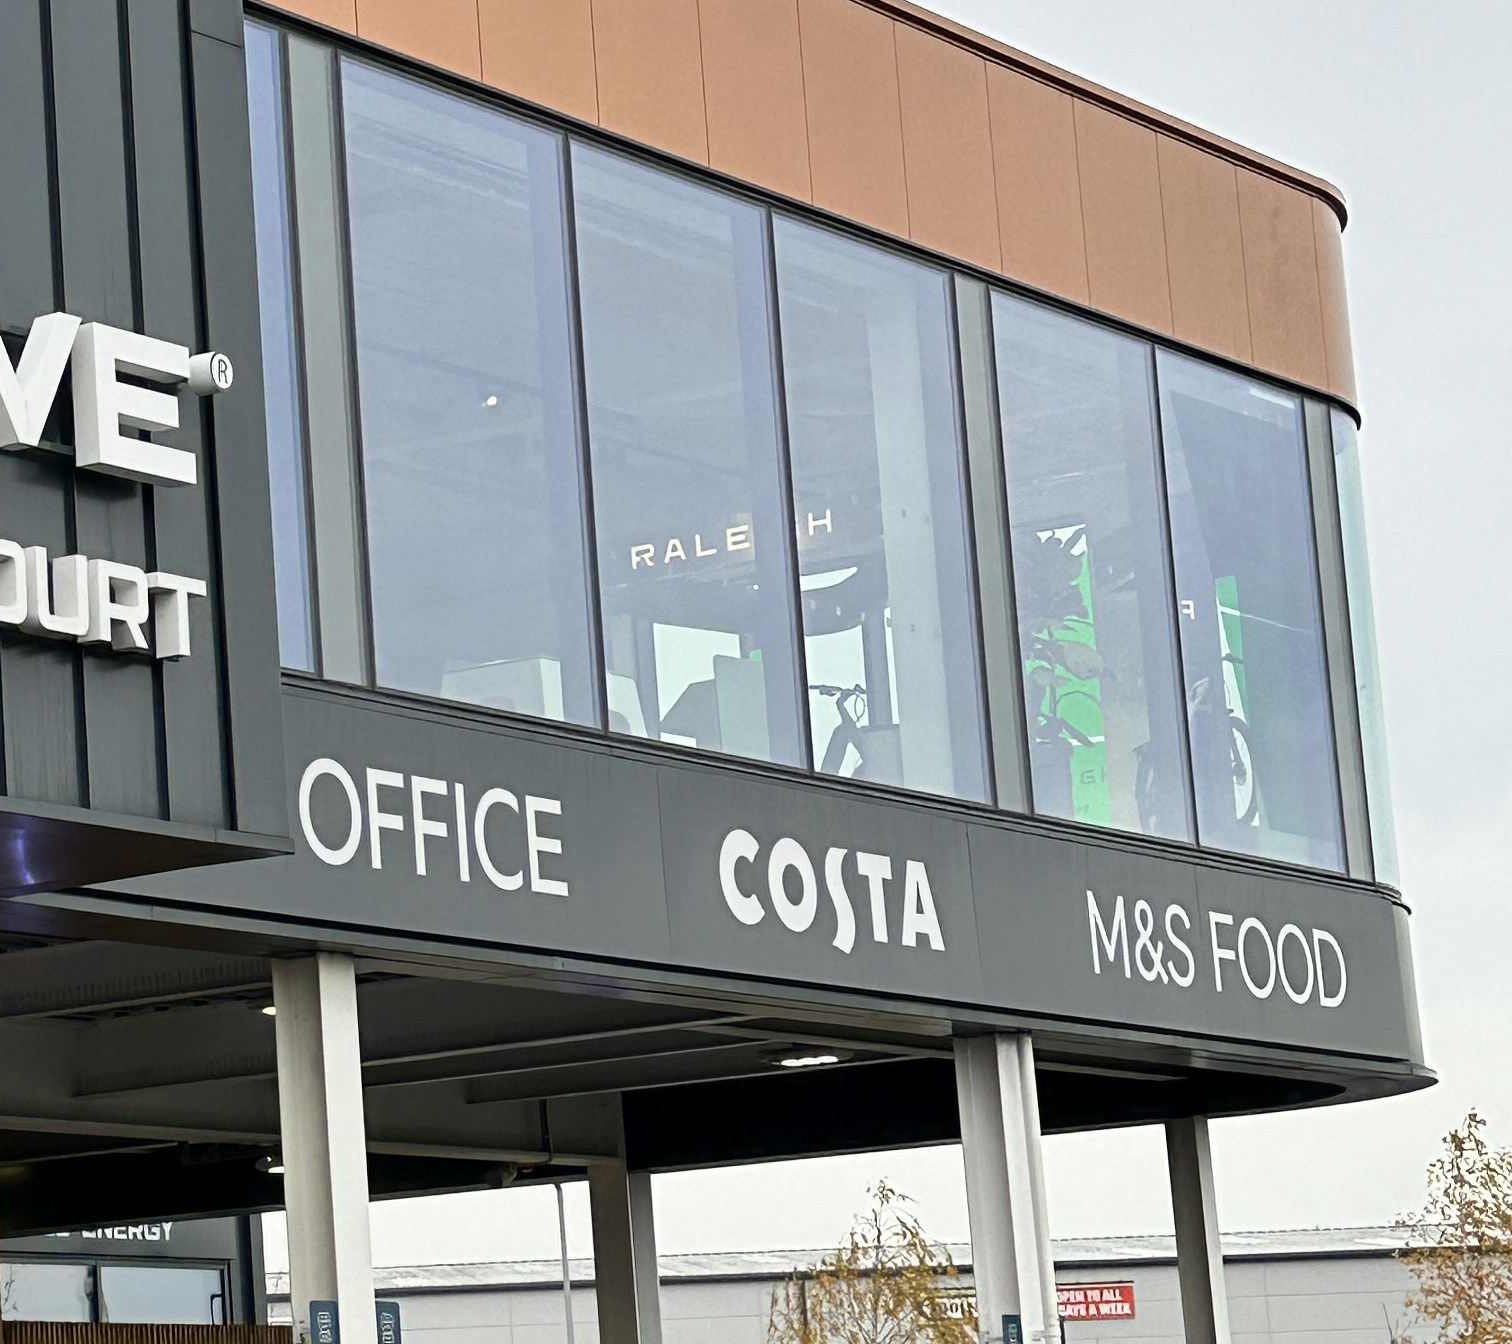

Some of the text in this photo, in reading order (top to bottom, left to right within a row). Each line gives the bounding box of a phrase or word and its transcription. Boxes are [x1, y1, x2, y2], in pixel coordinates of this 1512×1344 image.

[630, 509, 832, 570] RALEH
[298, 758, 570, 897] OFFICE
[719, 828, 946, 955] COSTA
[1087, 890, 1347, 1009] M&S FOOD
